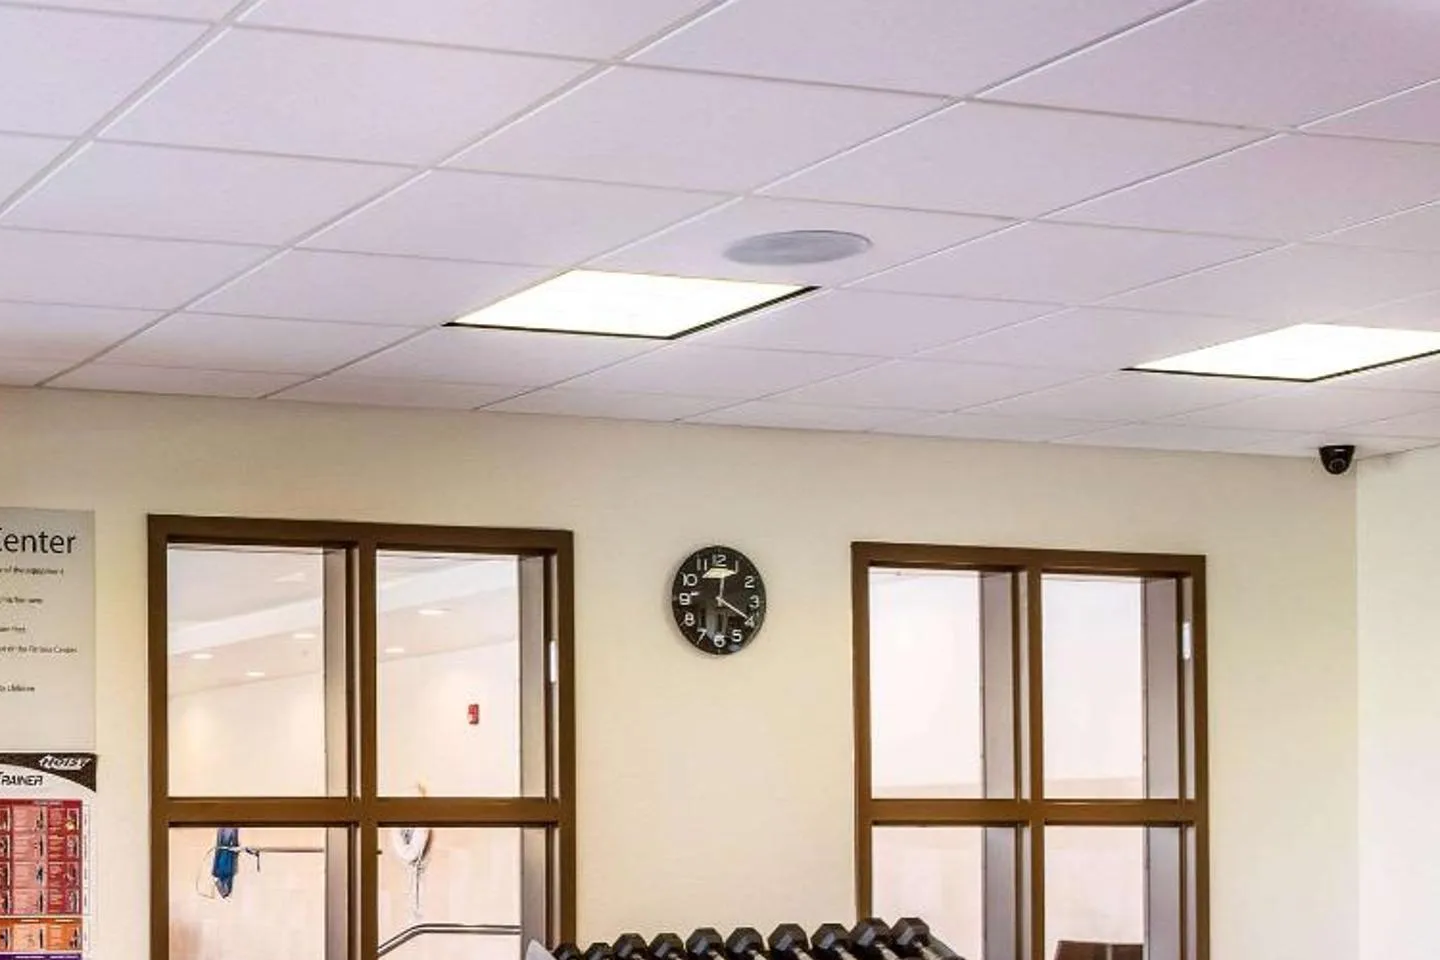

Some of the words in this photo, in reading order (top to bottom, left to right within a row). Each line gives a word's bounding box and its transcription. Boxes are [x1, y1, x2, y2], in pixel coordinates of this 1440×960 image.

[712, 554, 727, 567] 12
[681, 573, 698, 587] 10
[744, 575, 755, 588] 2
[679, 592, 690, 606] 9
[749, 595, 760, 609] 3
[685, 612, 696, 627] 8
[696, 628, 708, 645] 7
[714, 634, 726, 648] 6
[731, 629, 742, 642] 5
